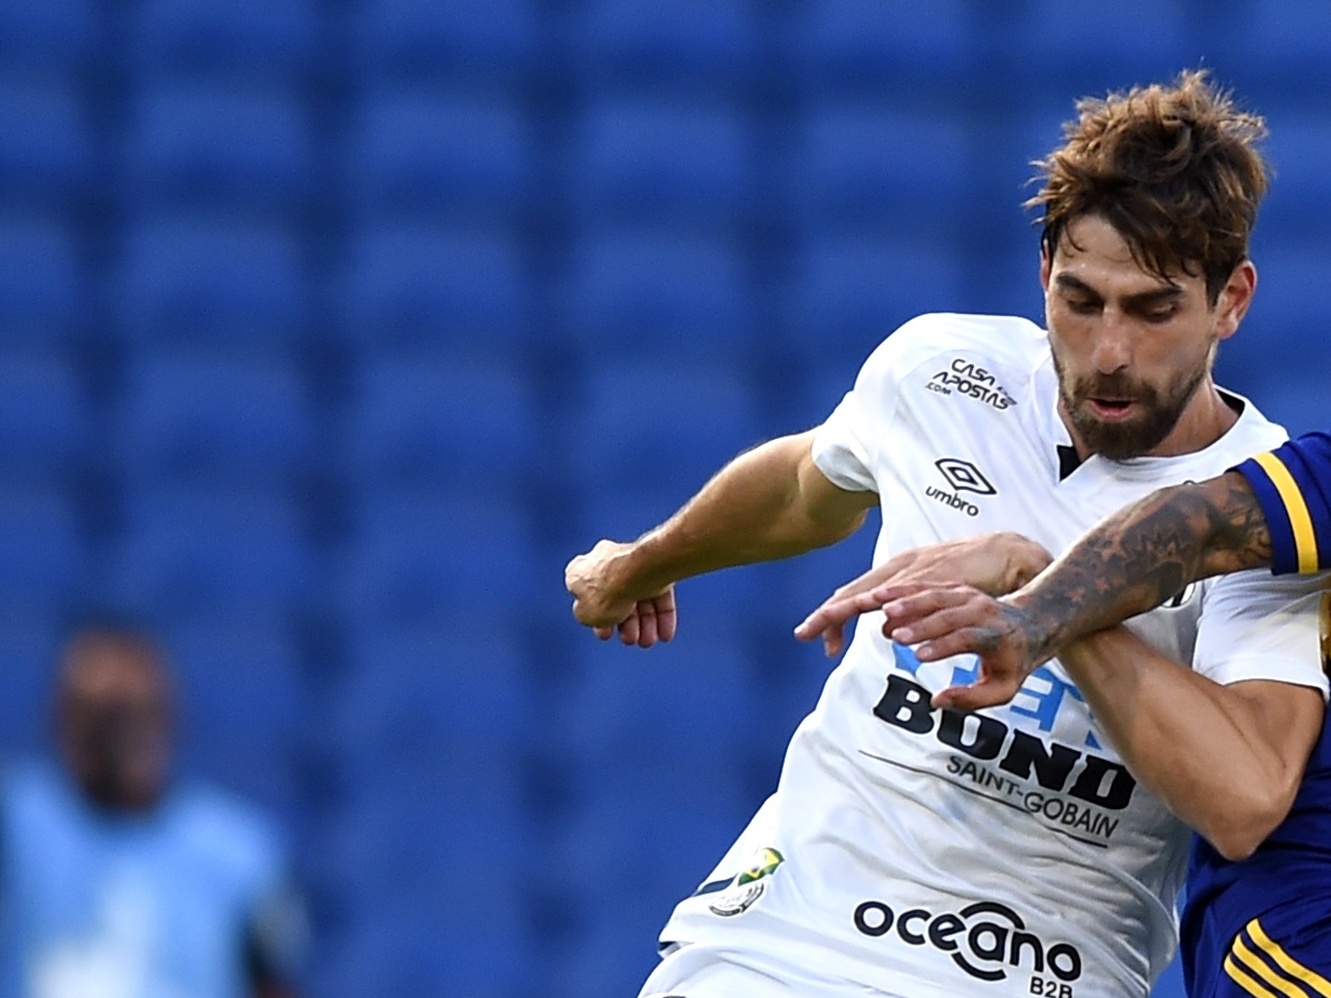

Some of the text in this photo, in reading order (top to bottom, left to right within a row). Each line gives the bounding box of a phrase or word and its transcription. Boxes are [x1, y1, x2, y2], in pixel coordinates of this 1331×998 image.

[932, 371, 1010, 410] APOSTAS
[925, 485, 980, 517] umbro
[872, 673, 1137, 811] BOND
[946, 755, 1120, 839] SAINT-GOBAIN
[853, 900, 1083, 983] oceano
